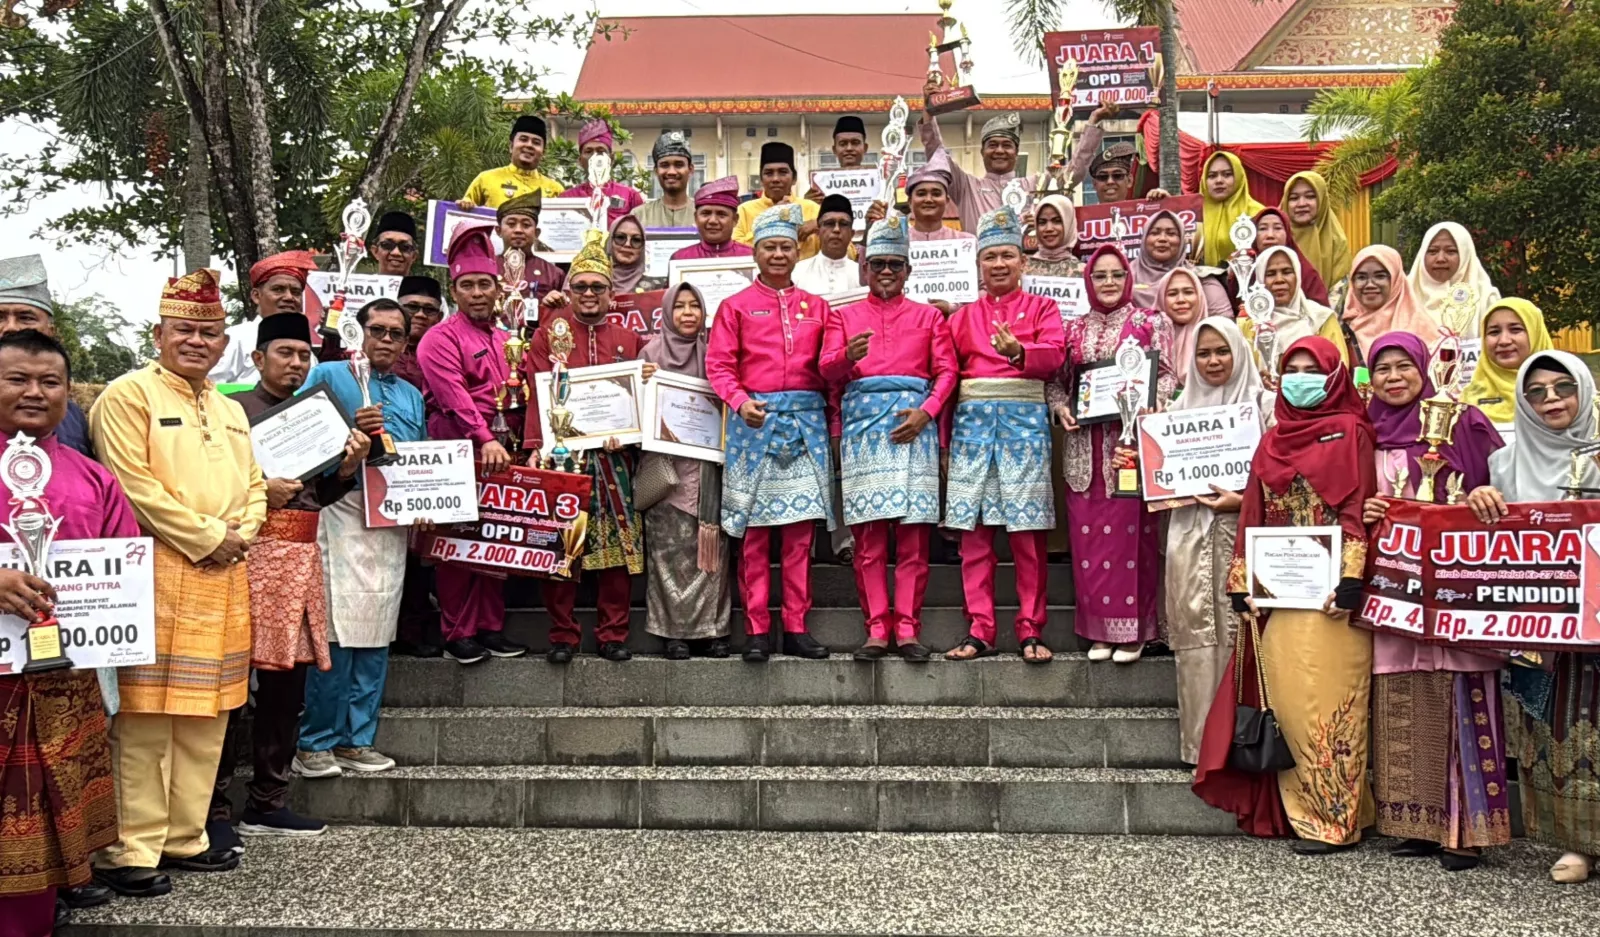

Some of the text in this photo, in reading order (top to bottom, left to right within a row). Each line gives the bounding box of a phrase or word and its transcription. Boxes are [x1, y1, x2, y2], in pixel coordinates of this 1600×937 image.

[1056, 42, 1155, 65] JUARA 1
[1088, 73, 1121, 86] OPD
[826, 178, 867, 189] JUARA
[1178, 210, 1196, 231] 2
[910, 249, 949, 260] UARA
[913, 281, 969, 294] 1.000.000
[1161, 418, 1224, 437] JUARA
[396, 454, 443, 467] UARA
[1154, 460, 1252, 486] Rp 1.000.000
[384, 496, 461, 515] Rp 500.000
[555, 493, 580, 520] 3
[481, 522, 524, 542] OPD
[430, 537, 566, 573] Rp. 2.000.000,-
[1430, 529, 1582, 565] JUARA
[105, 558, 122, 576] II
[1435, 569, 1577, 581] Kirab Budaya Helat Ke-27 Kab.
[86, 581, 121, 590] PUTRA
[98, 602, 137, 610] PELALAWAN
[1361, 594, 1396, 626] Rp.
[1433, 610, 1474, 641] Rp.
[0, 636, 11, 658] p
